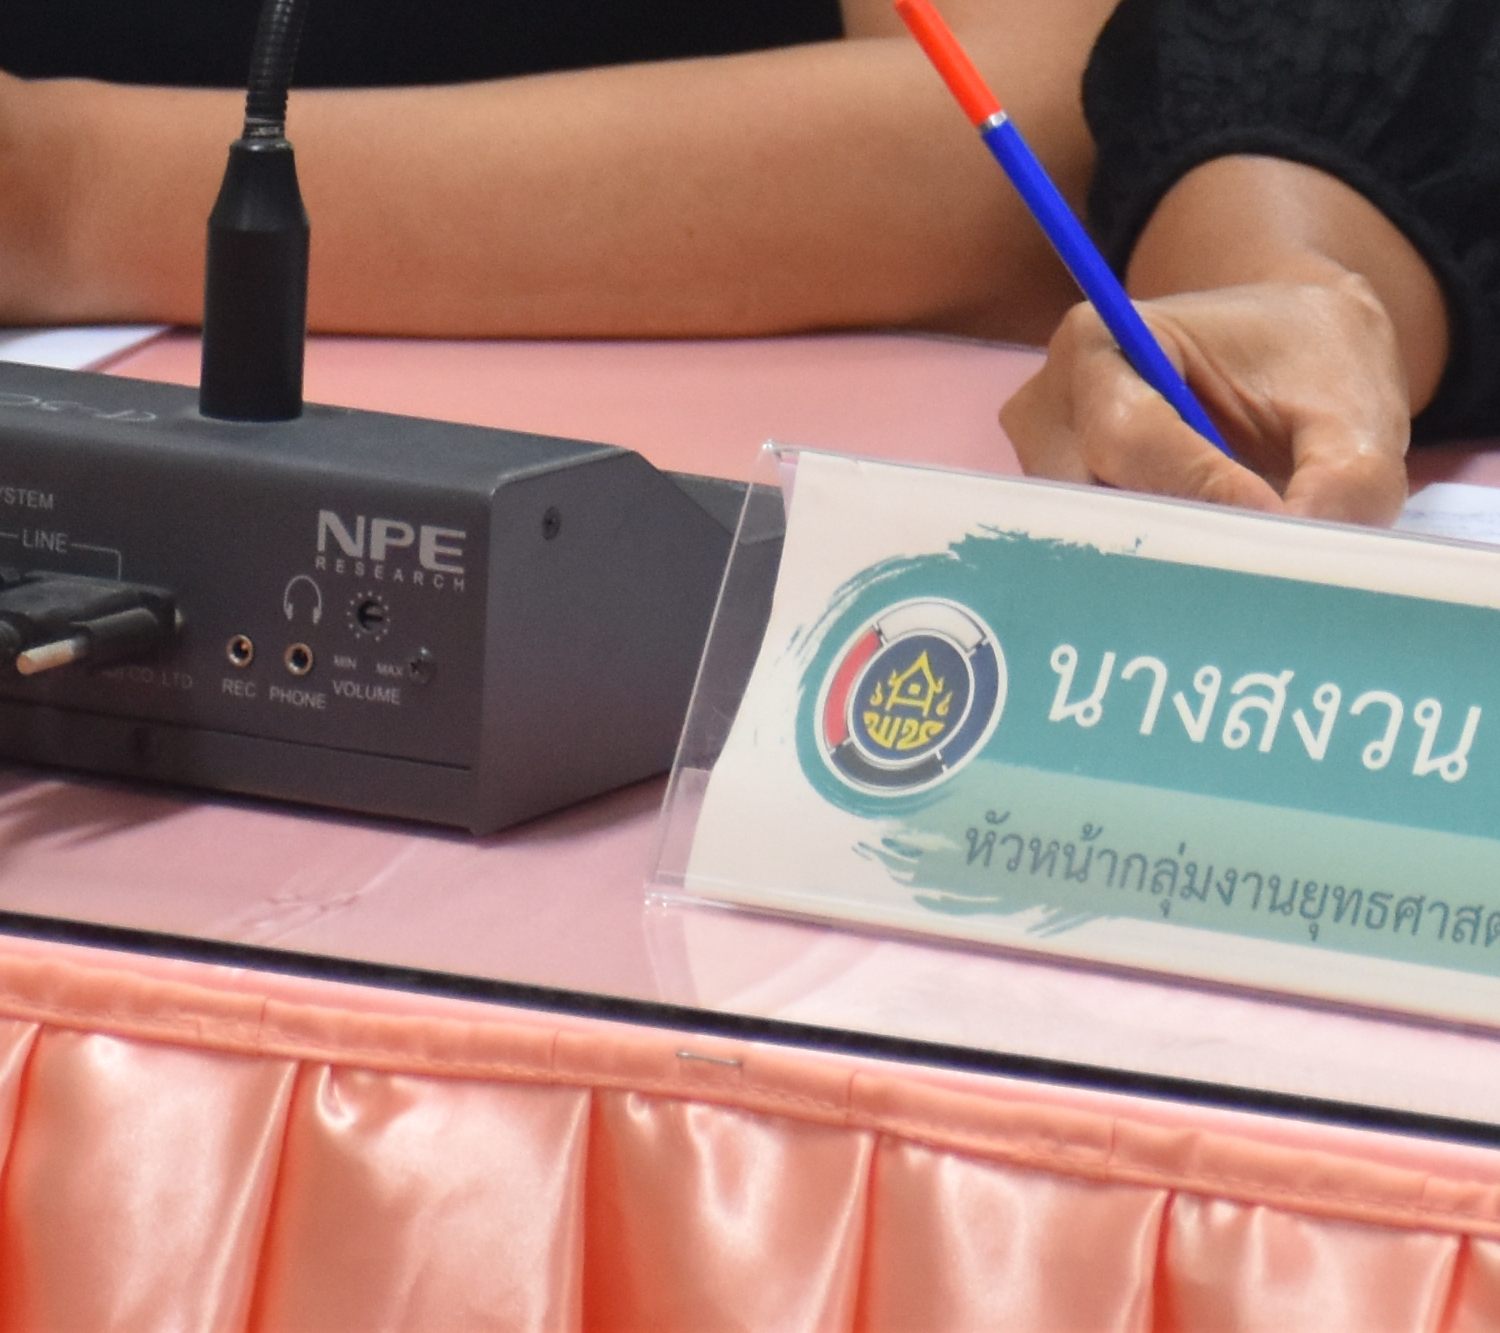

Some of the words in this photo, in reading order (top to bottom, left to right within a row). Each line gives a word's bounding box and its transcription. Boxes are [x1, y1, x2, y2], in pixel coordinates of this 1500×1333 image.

[21, 528, 69, 554] LINE
[316, 508, 467, 575] NPE
[315, 555, 465, 592] RESEARCH
[333, 655, 357, 671] MIN
[376, 662, 402, 678] MAX
[222, 678, 256, 698] REC
[269, 685, 327, 710] PHONE
[332, 680, 401, 705] VOLUME
[1048, 643, 1482, 783] นางสงวน
